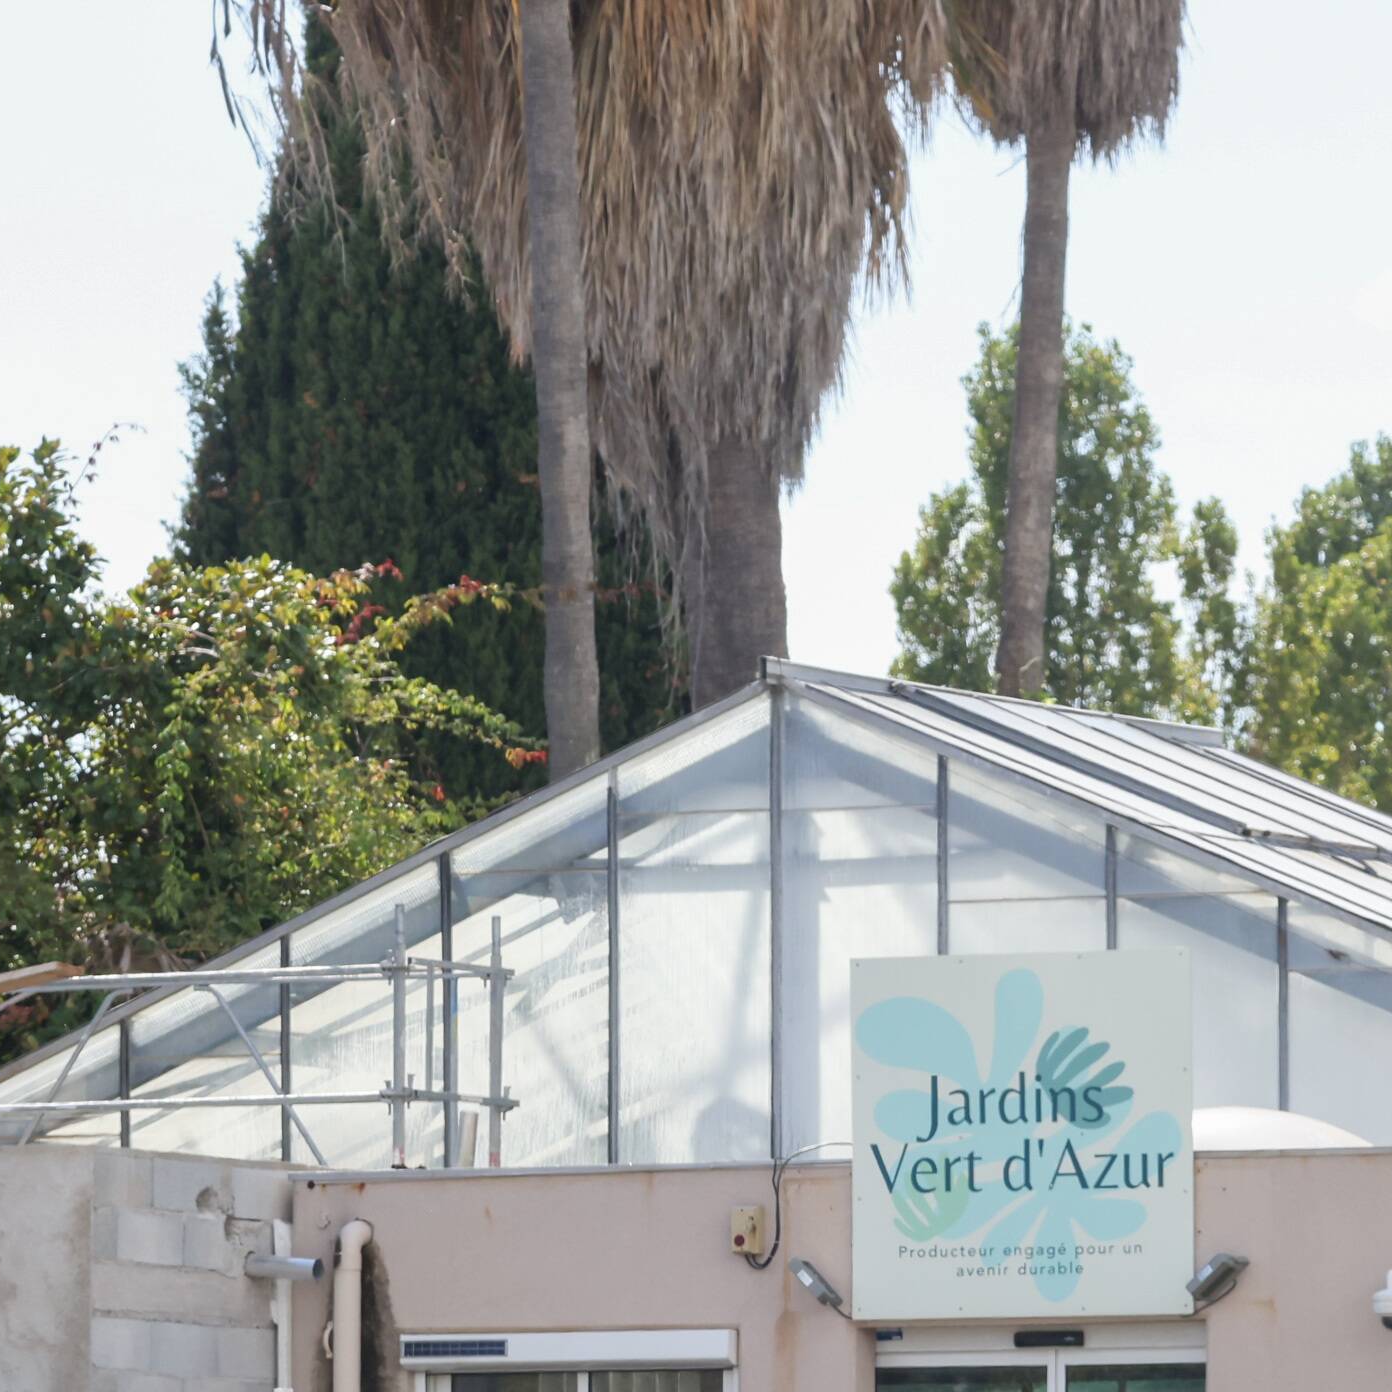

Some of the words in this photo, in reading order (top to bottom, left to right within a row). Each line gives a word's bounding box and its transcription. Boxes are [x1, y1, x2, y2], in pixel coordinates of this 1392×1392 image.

[916, 1071, 1104, 1143] Jardins
[870, 1143, 983, 1194] Vert
[1002, 1138, 1175, 1192] d'Azur
[898, 1244, 995, 1259] Producteur
[1002, 1241, 1067, 1261] engagé
[1074, 1244, 1114, 1260] pour
[1123, 1242, 1143, 1255] un
[956, 1263, 1008, 1278] avenir
[1018, 1261, 1084, 1277] durable
